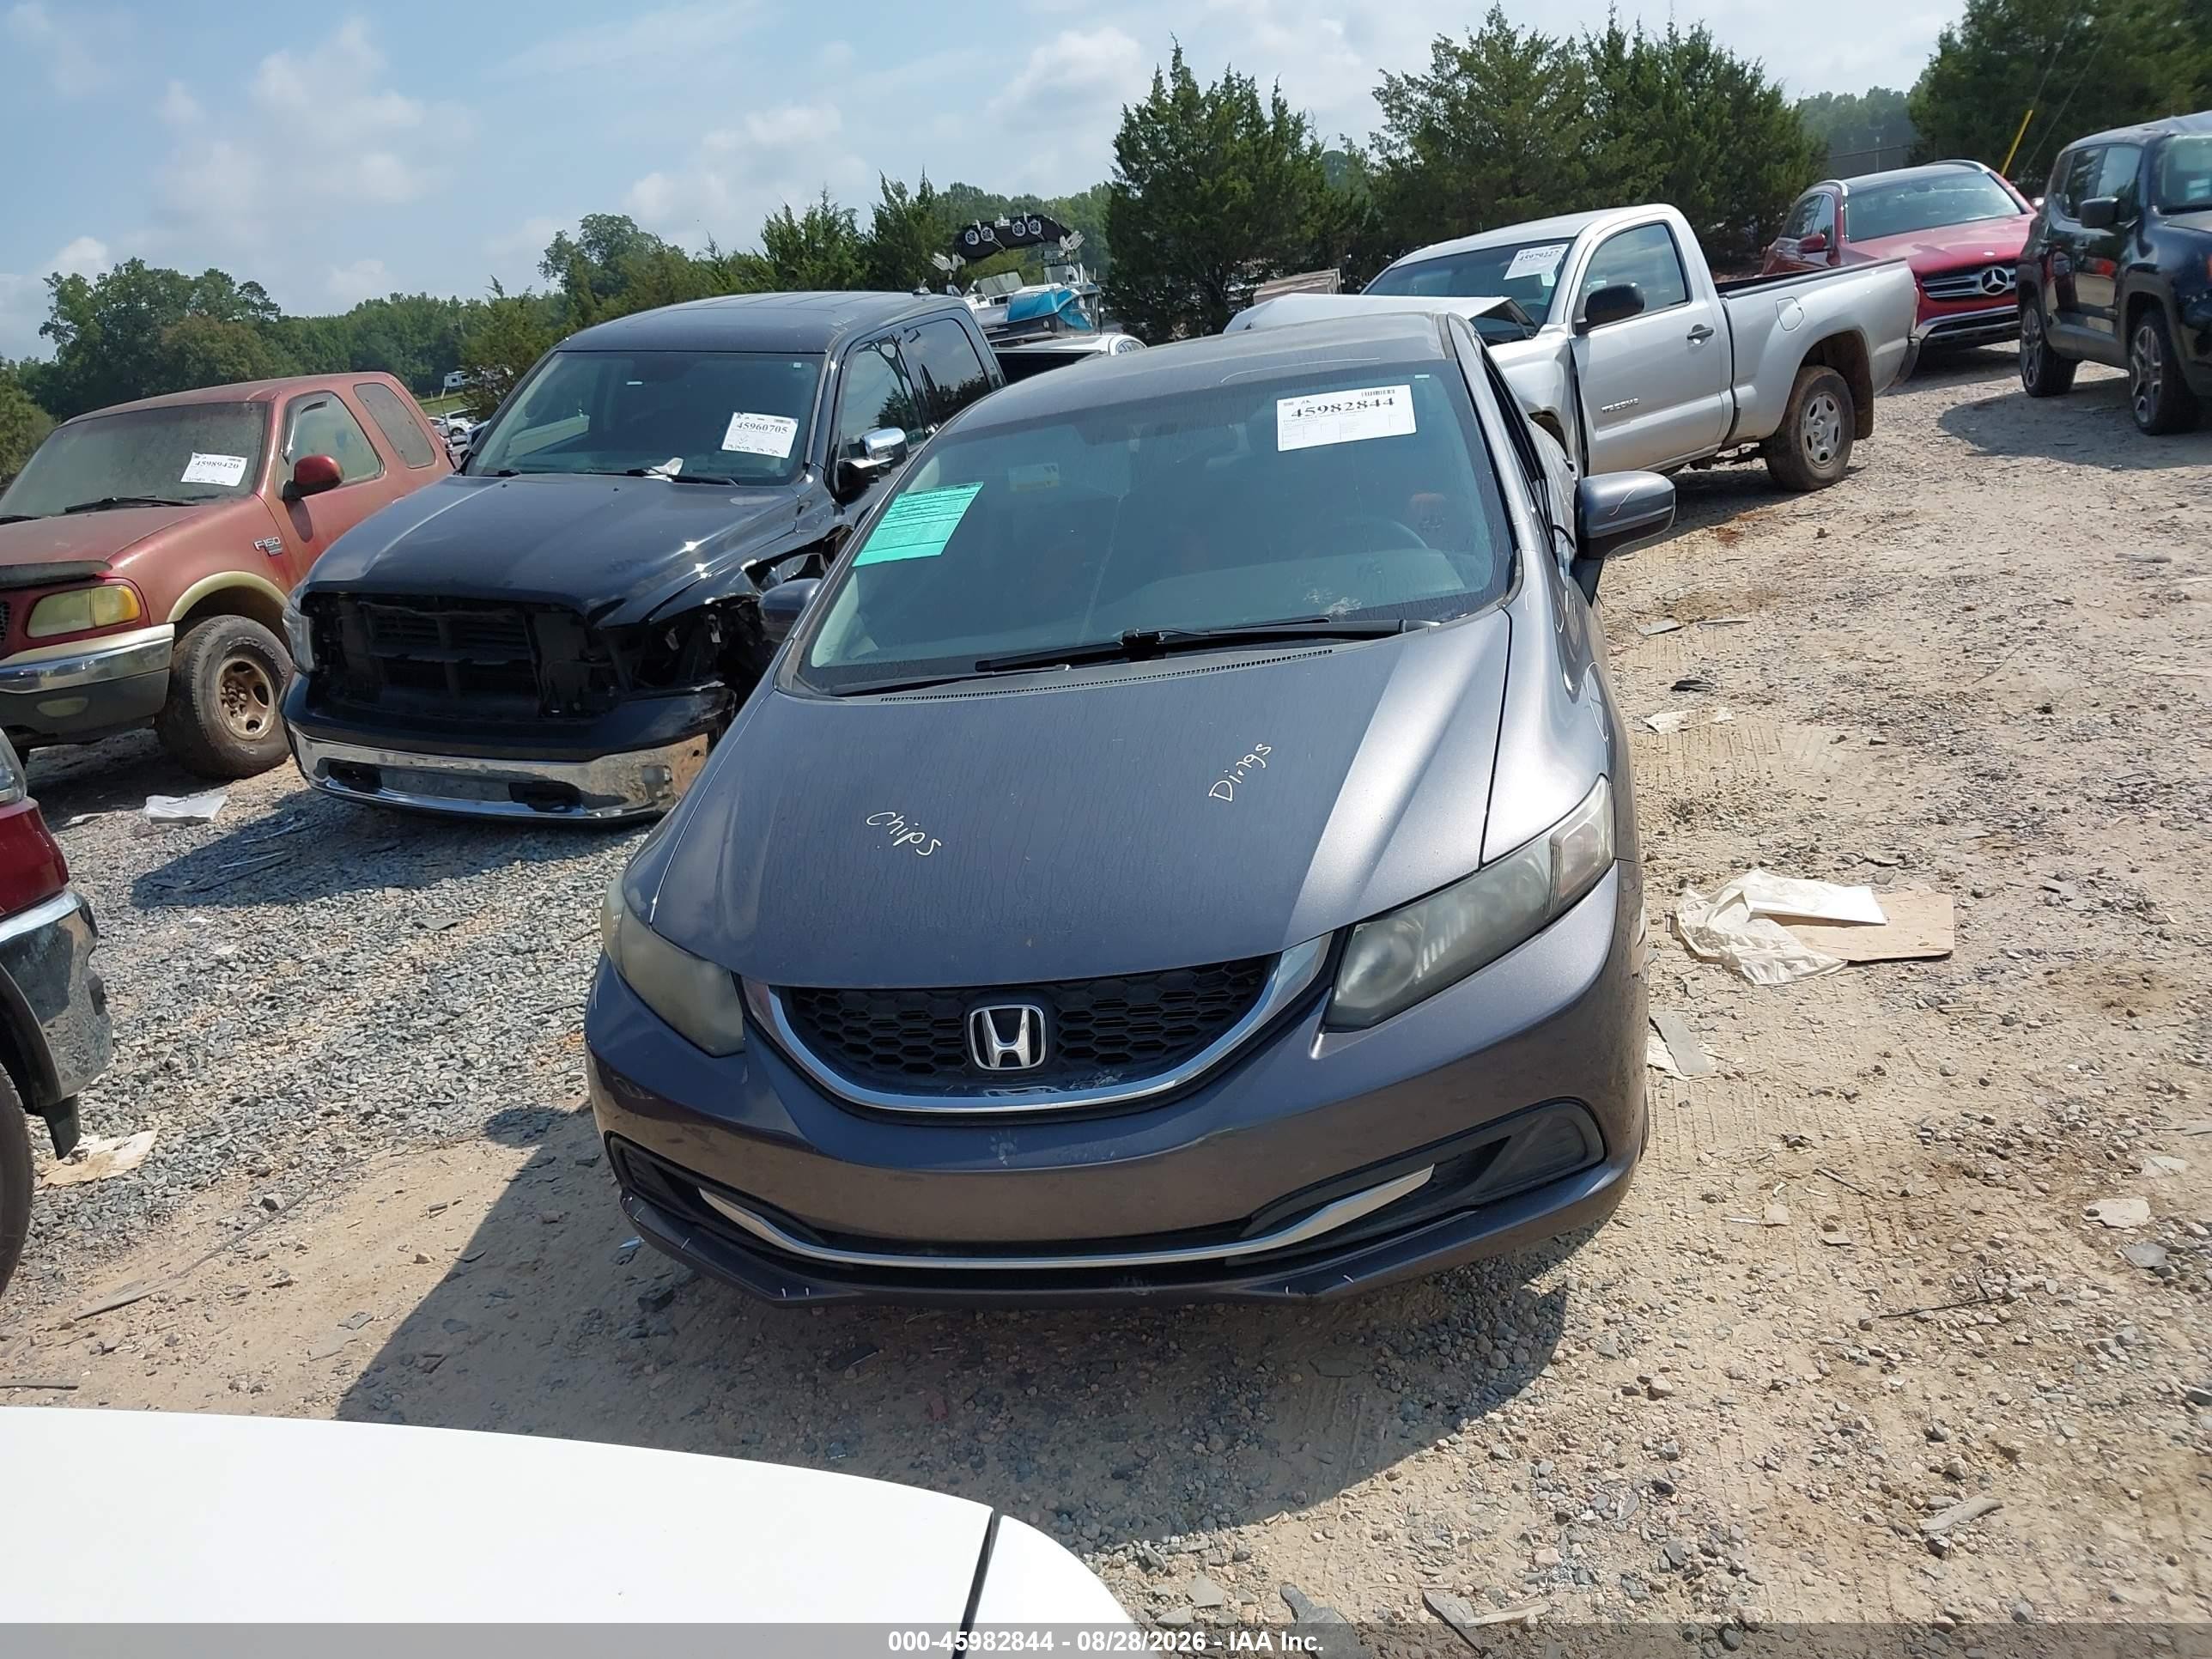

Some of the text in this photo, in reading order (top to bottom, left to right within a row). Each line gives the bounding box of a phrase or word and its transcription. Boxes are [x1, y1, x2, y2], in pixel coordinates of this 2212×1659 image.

[1291, 397, 1395, 418] 45982844
[737, 422, 789, 434] 45960705
[194, 459, 240, 469] 45989420
[1208, 743, 1272, 802] Dings
[866, 811, 942, 856] Chips
